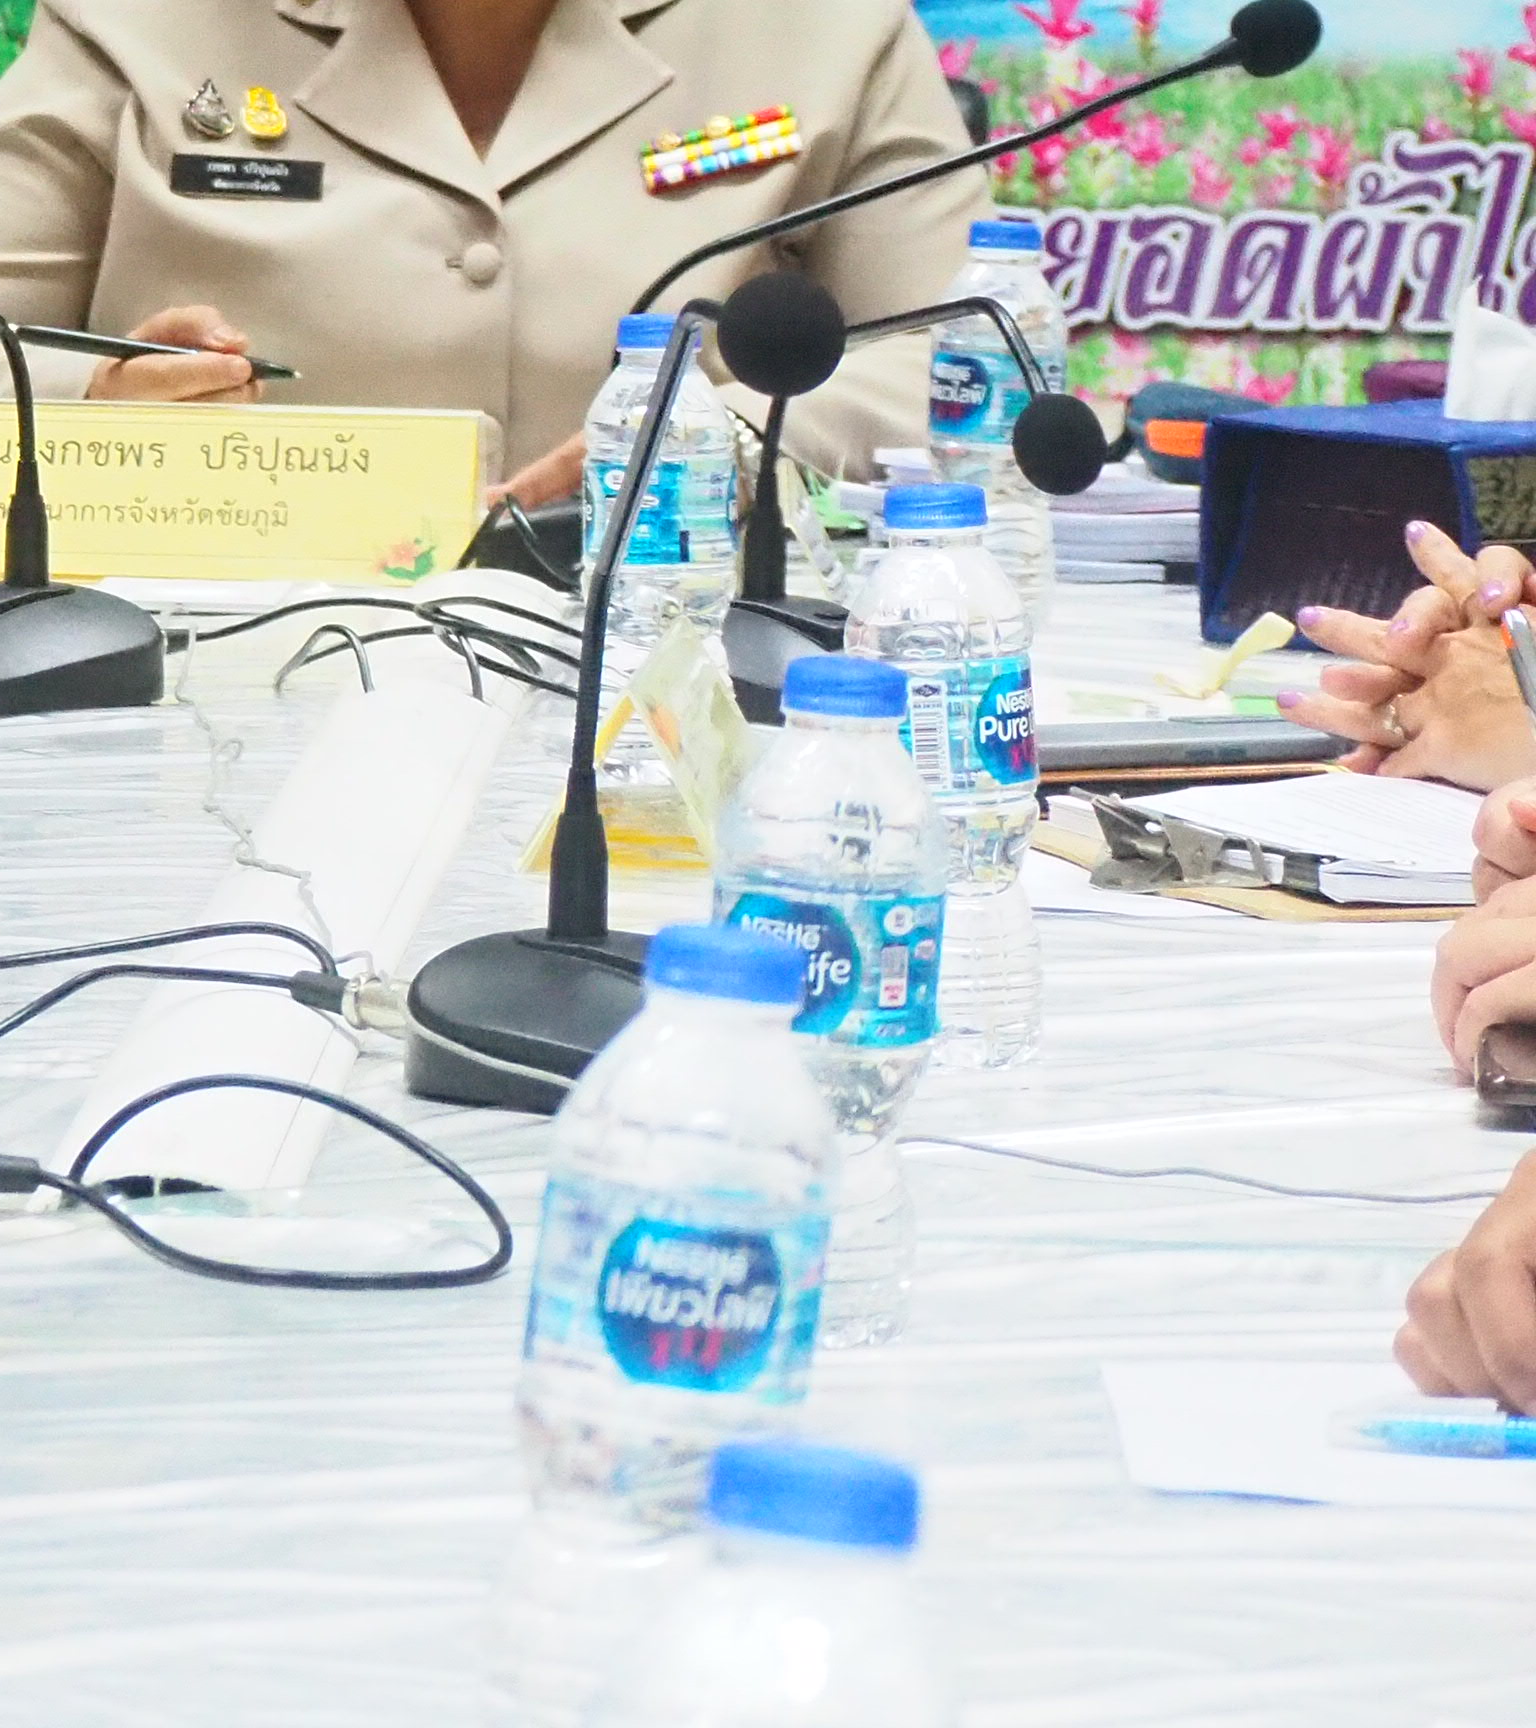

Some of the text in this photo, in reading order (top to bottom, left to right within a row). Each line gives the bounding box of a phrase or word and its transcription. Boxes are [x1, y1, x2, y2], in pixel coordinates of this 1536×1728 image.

[199, 430, 371, 486] ปริปุณนัง
[978, 715, 1029, 744] Pure
[807, 951, 852, 996] ife
